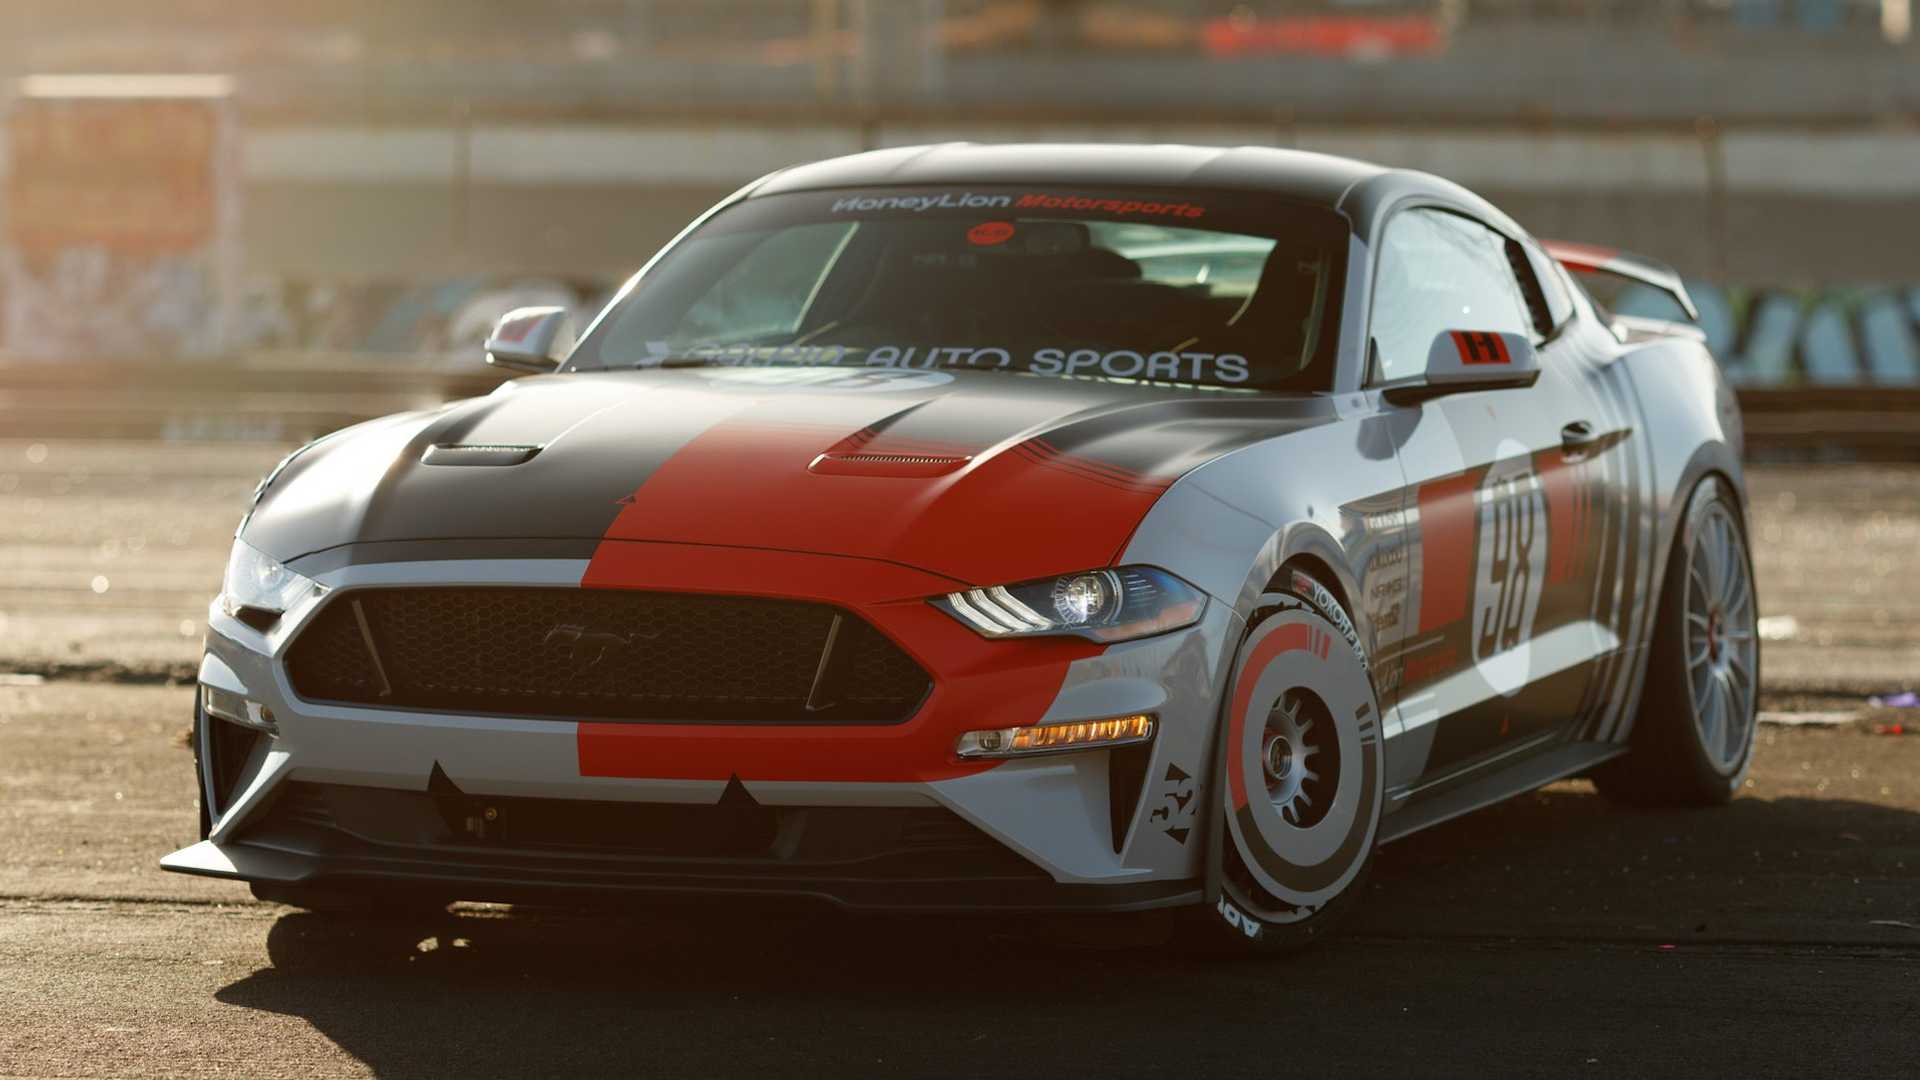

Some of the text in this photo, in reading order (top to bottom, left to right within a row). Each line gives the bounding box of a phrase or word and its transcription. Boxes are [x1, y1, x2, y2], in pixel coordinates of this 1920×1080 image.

[832, 191, 1205, 218] MoneyLion Motorsports
[865, 346, 1010, 369] AUTO
[1029, 346, 1249, 382] SPORTS
[1478, 471, 1537, 662] 98
